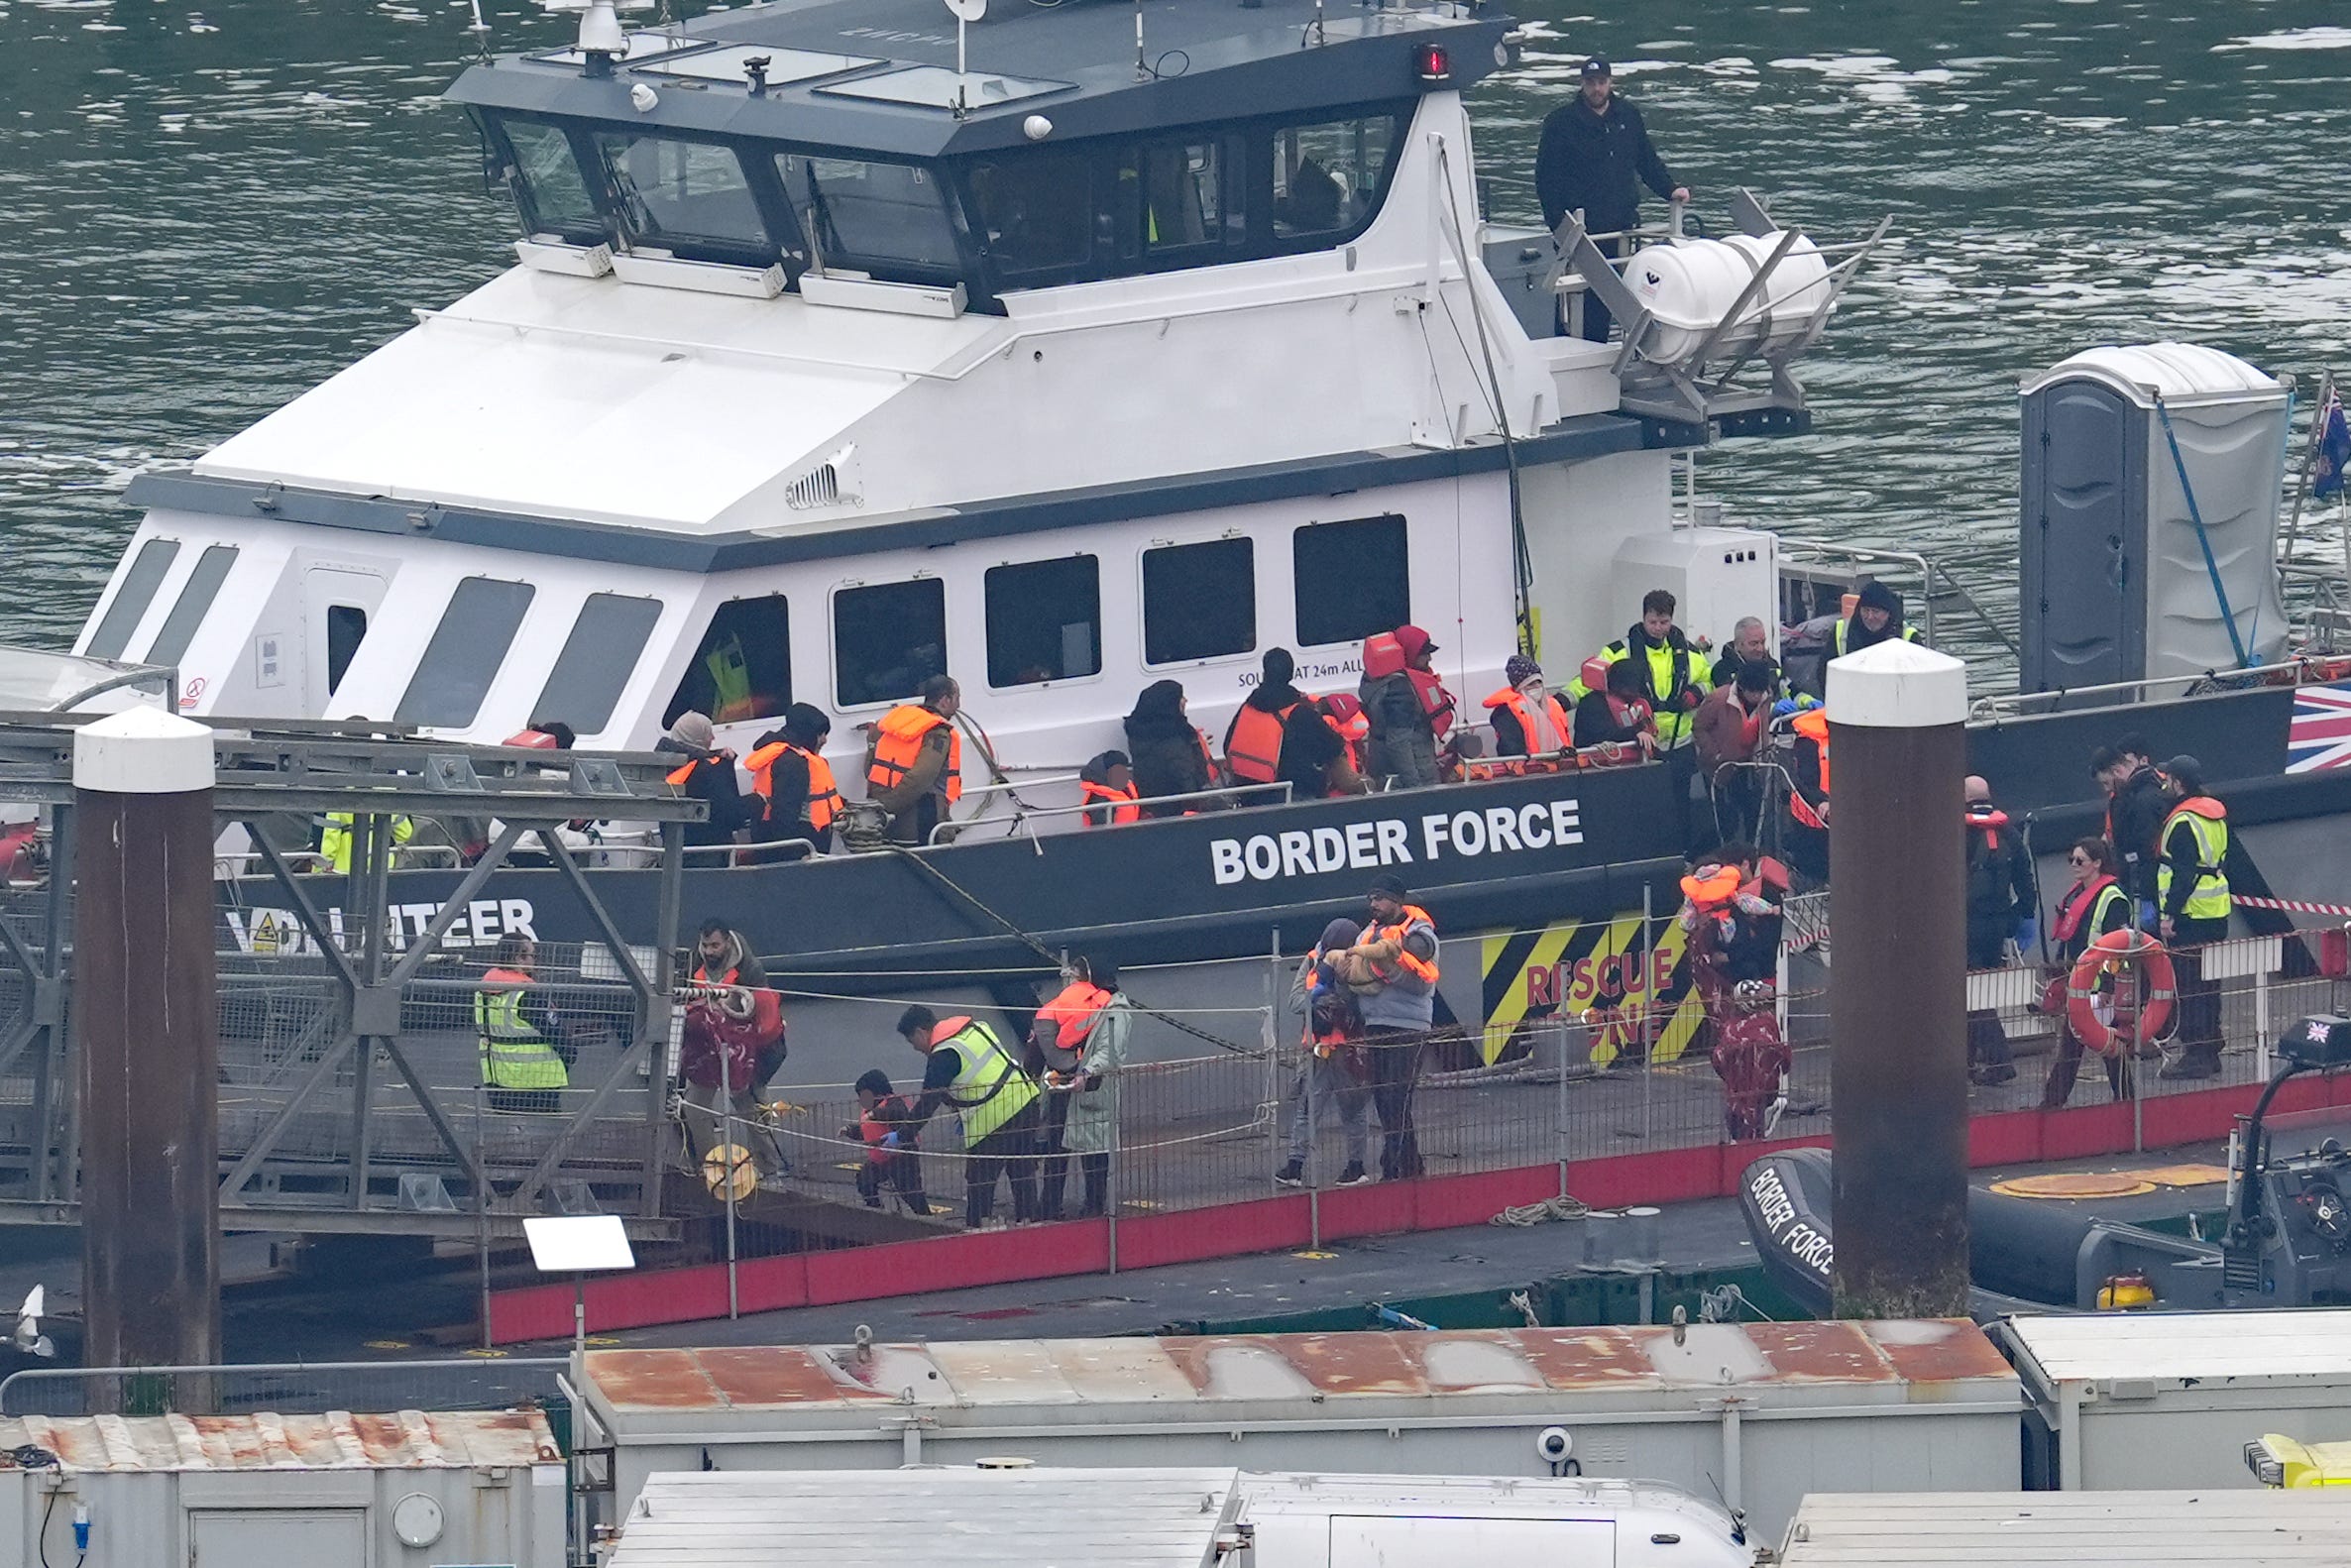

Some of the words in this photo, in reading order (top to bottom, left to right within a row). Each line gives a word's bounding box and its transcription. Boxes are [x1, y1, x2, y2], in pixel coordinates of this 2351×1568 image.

[1313, 664, 1338, 678] 24m
[1342, 658, 1363, 673] ALL
[1210, 819, 1413, 885] BORDER
[1421, 799, 1584, 860] FORCE
[1526, 949, 1674, 1008] RESCUE
[1750, 1168, 1796, 1235] BORDER
[1781, 1222, 1834, 1276] FORCE
